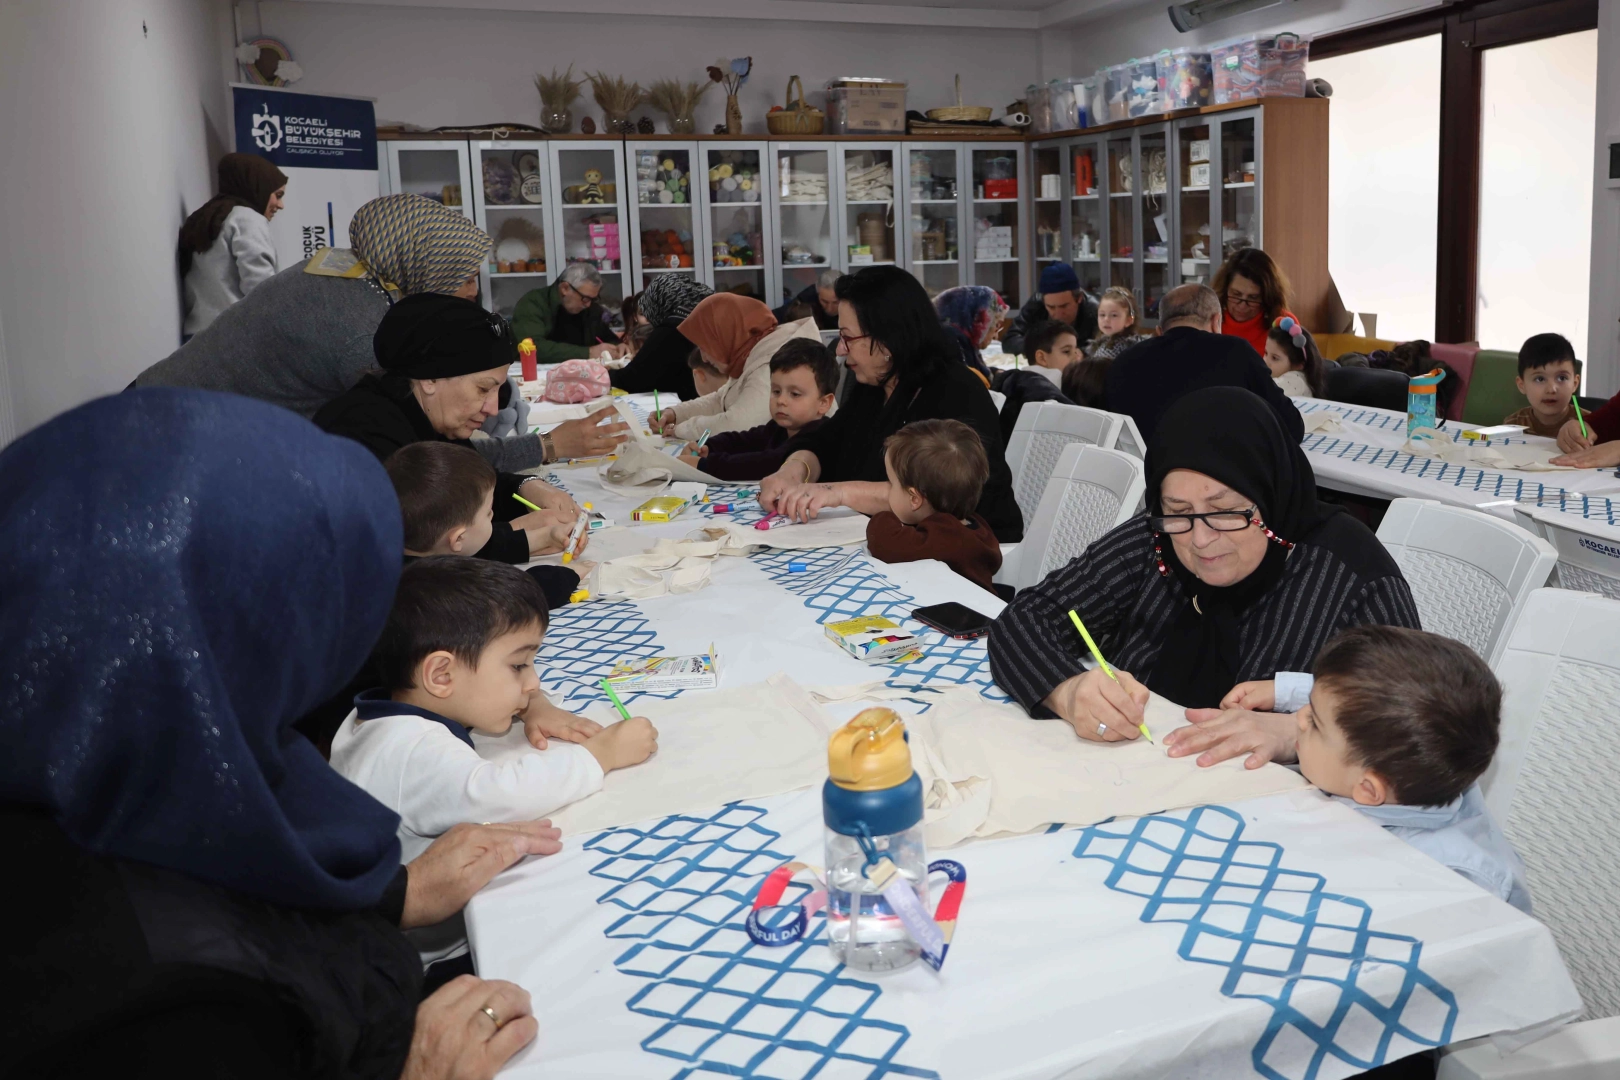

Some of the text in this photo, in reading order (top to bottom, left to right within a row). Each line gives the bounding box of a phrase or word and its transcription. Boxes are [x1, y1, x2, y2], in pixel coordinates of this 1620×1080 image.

[285, 125, 361, 138] BÜYÜKŞEHİR
[285, 135, 344, 146] BELEDİYESİ
[312, 226, 325, 251] ÖYÜ
[781, 921, 801, 941] DAY
